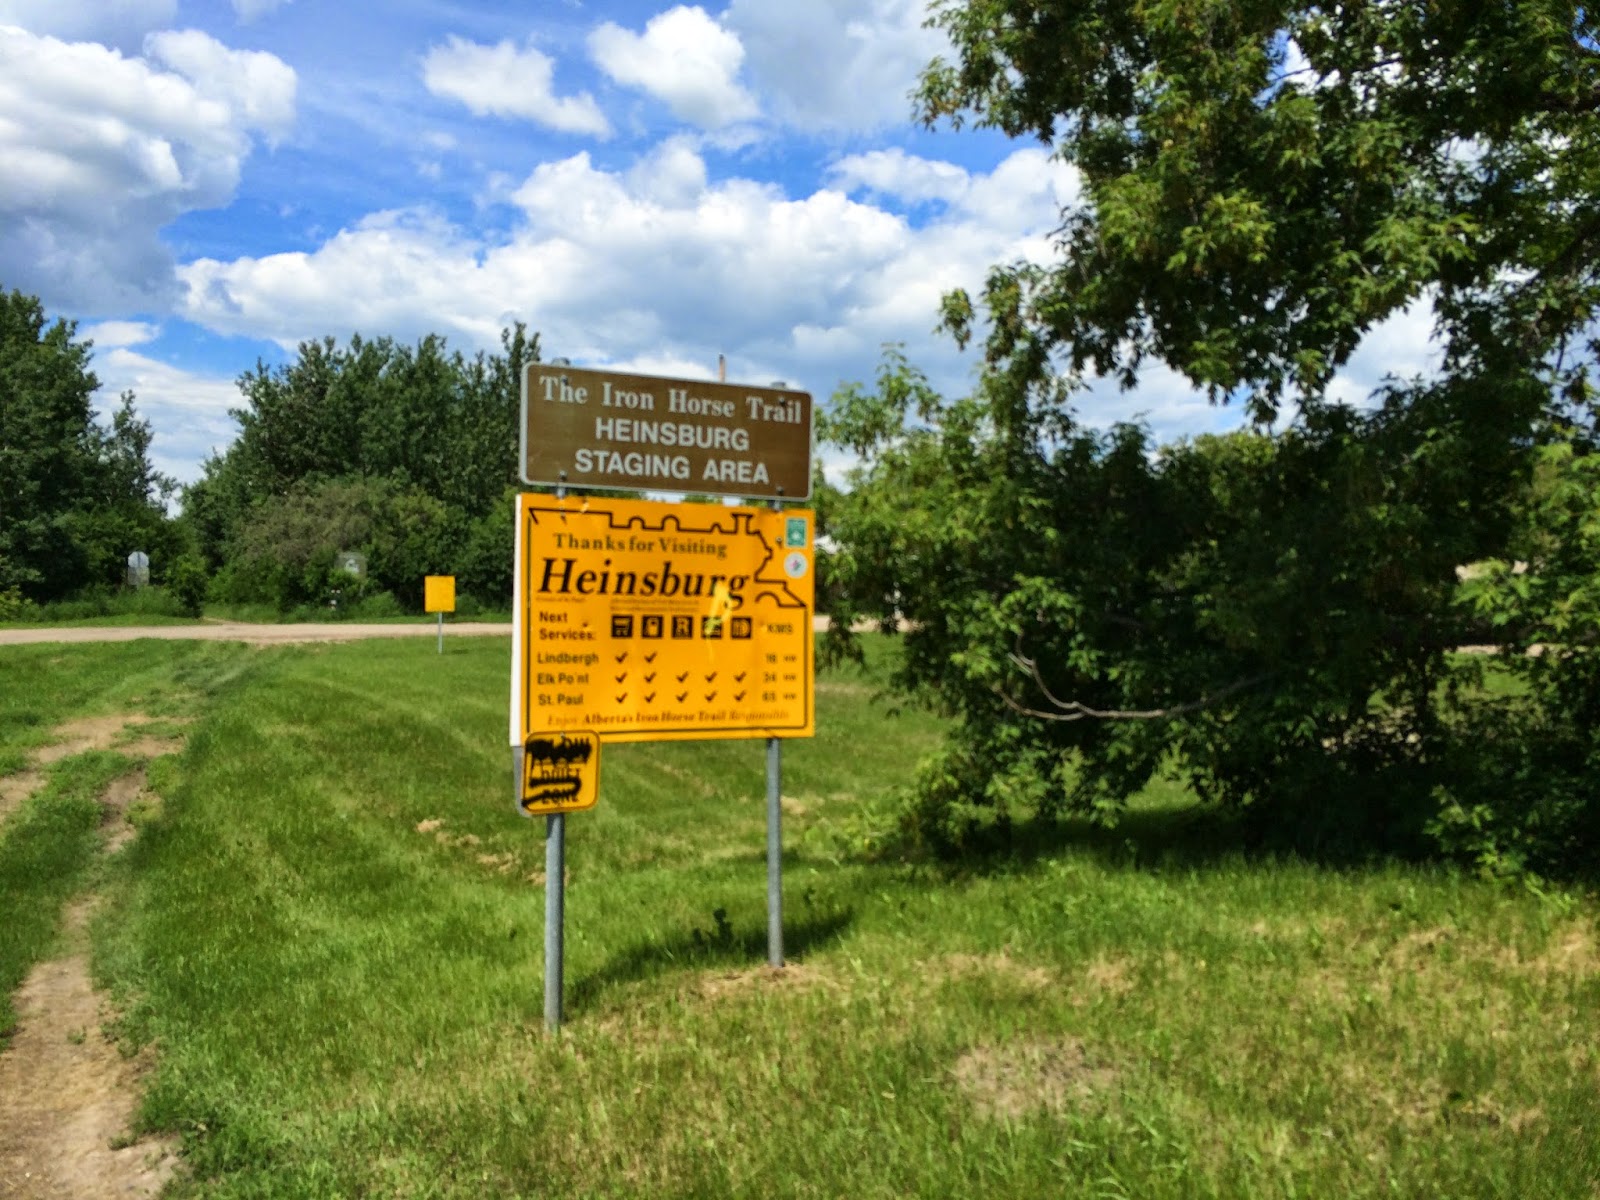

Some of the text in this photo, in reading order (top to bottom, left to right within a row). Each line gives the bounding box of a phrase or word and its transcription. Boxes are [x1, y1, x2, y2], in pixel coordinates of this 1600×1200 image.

[539, 375, 802, 424] The Iron Horse Trail
[595, 417, 750, 451] HEINSBURG
[575, 448, 769, 485] STAGING AREA
[553, 533, 727, 558] Thanks for Visiting
[538, 557, 750, 609] Heinsburg
[539, 611, 568, 623] Next
[537, 652, 599, 666] Lindbergh
[537, 673, 555, 685] Elk
[538, 693, 584, 706] St. Paul
